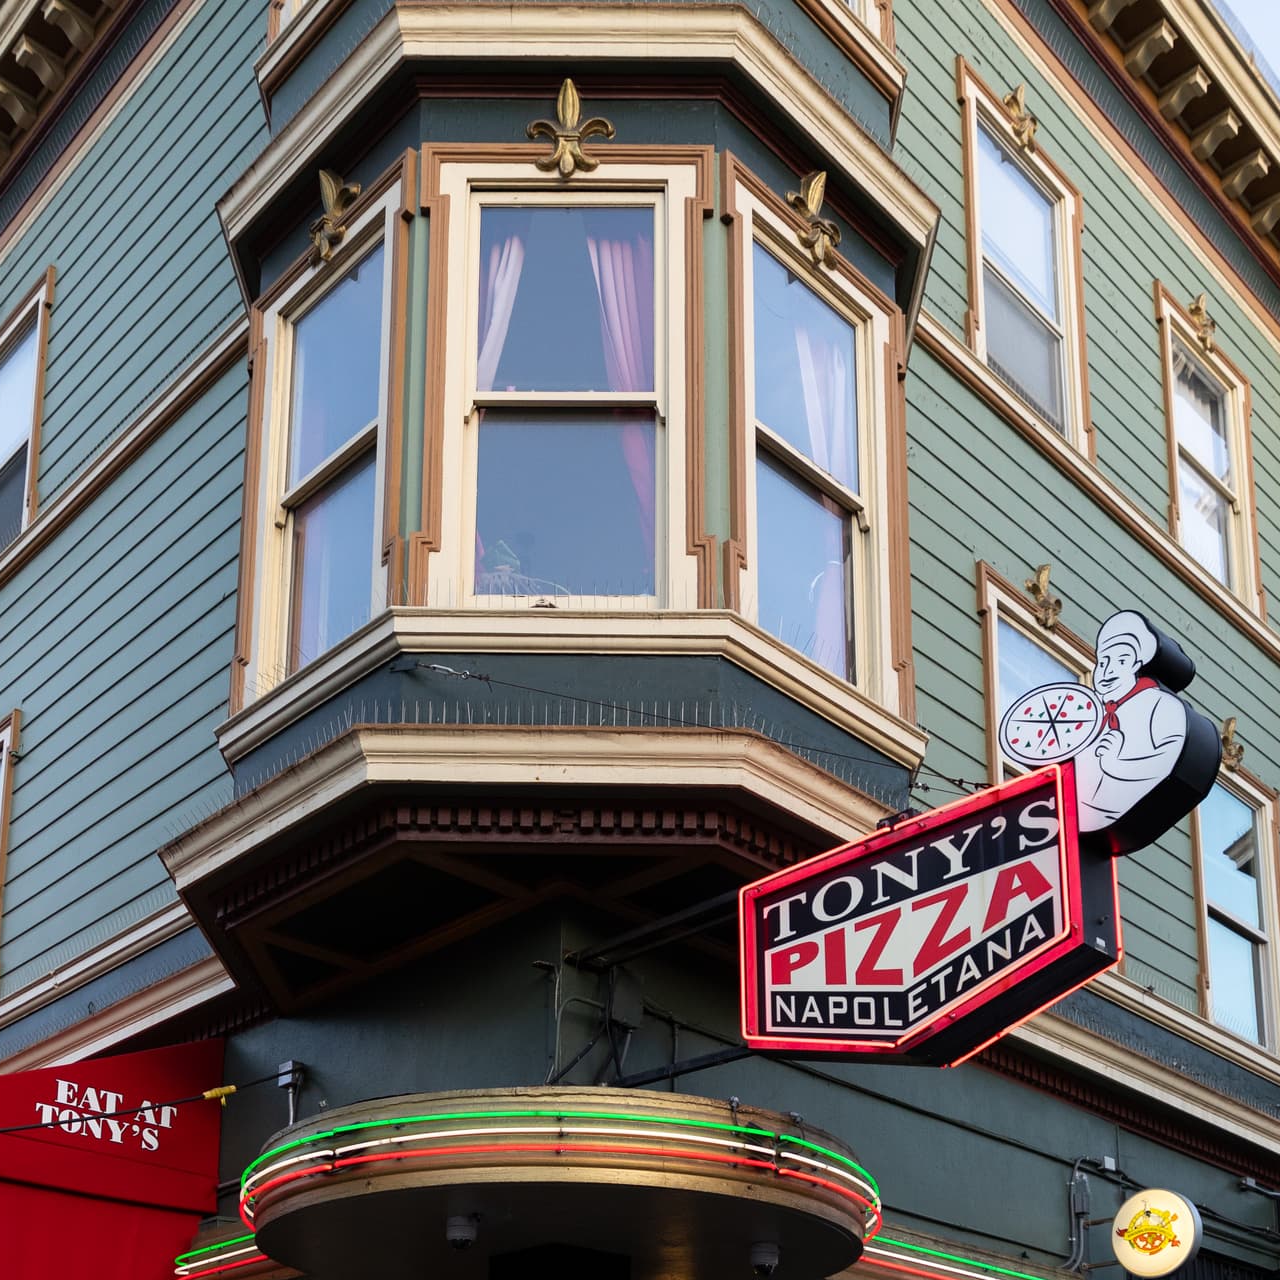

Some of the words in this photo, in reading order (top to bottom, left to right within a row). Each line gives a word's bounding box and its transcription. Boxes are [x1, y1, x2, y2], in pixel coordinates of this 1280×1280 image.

[763, 796, 1061, 942] TONY'S
[770, 860, 1055, 986] PIZZA
[775, 914, 1047, 1028] NAPOLETANA
[35, 1102, 160, 1152] TONY'S
[54, 1078, 124, 1115] EAT
[134, 1099, 178, 1129] AT
